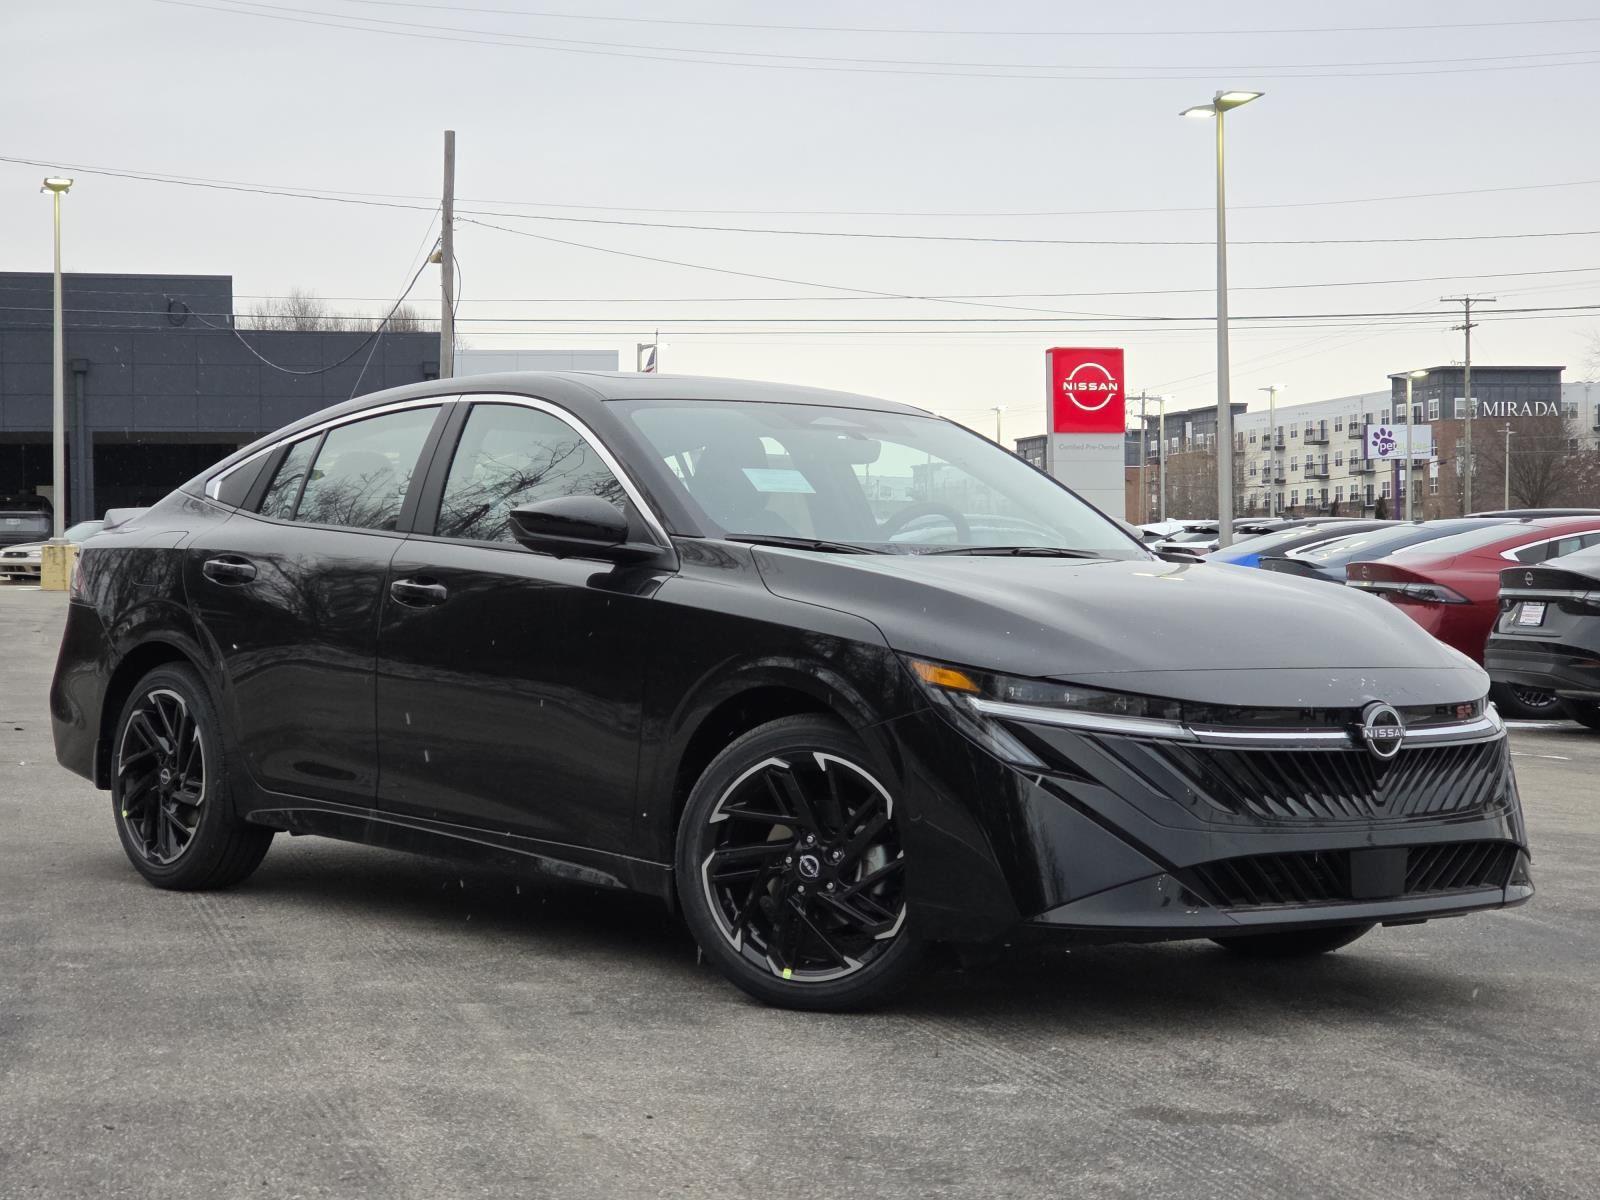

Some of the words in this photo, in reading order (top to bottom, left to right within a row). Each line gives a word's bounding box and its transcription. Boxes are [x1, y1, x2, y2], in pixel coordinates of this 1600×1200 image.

[1062, 381, 1119, 391] NISSAN
[1483, 401, 1559, 416] MIRADA
[1457, 704, 1473, 718] SR
[1364, 728, 1406, 738] NISSAN
